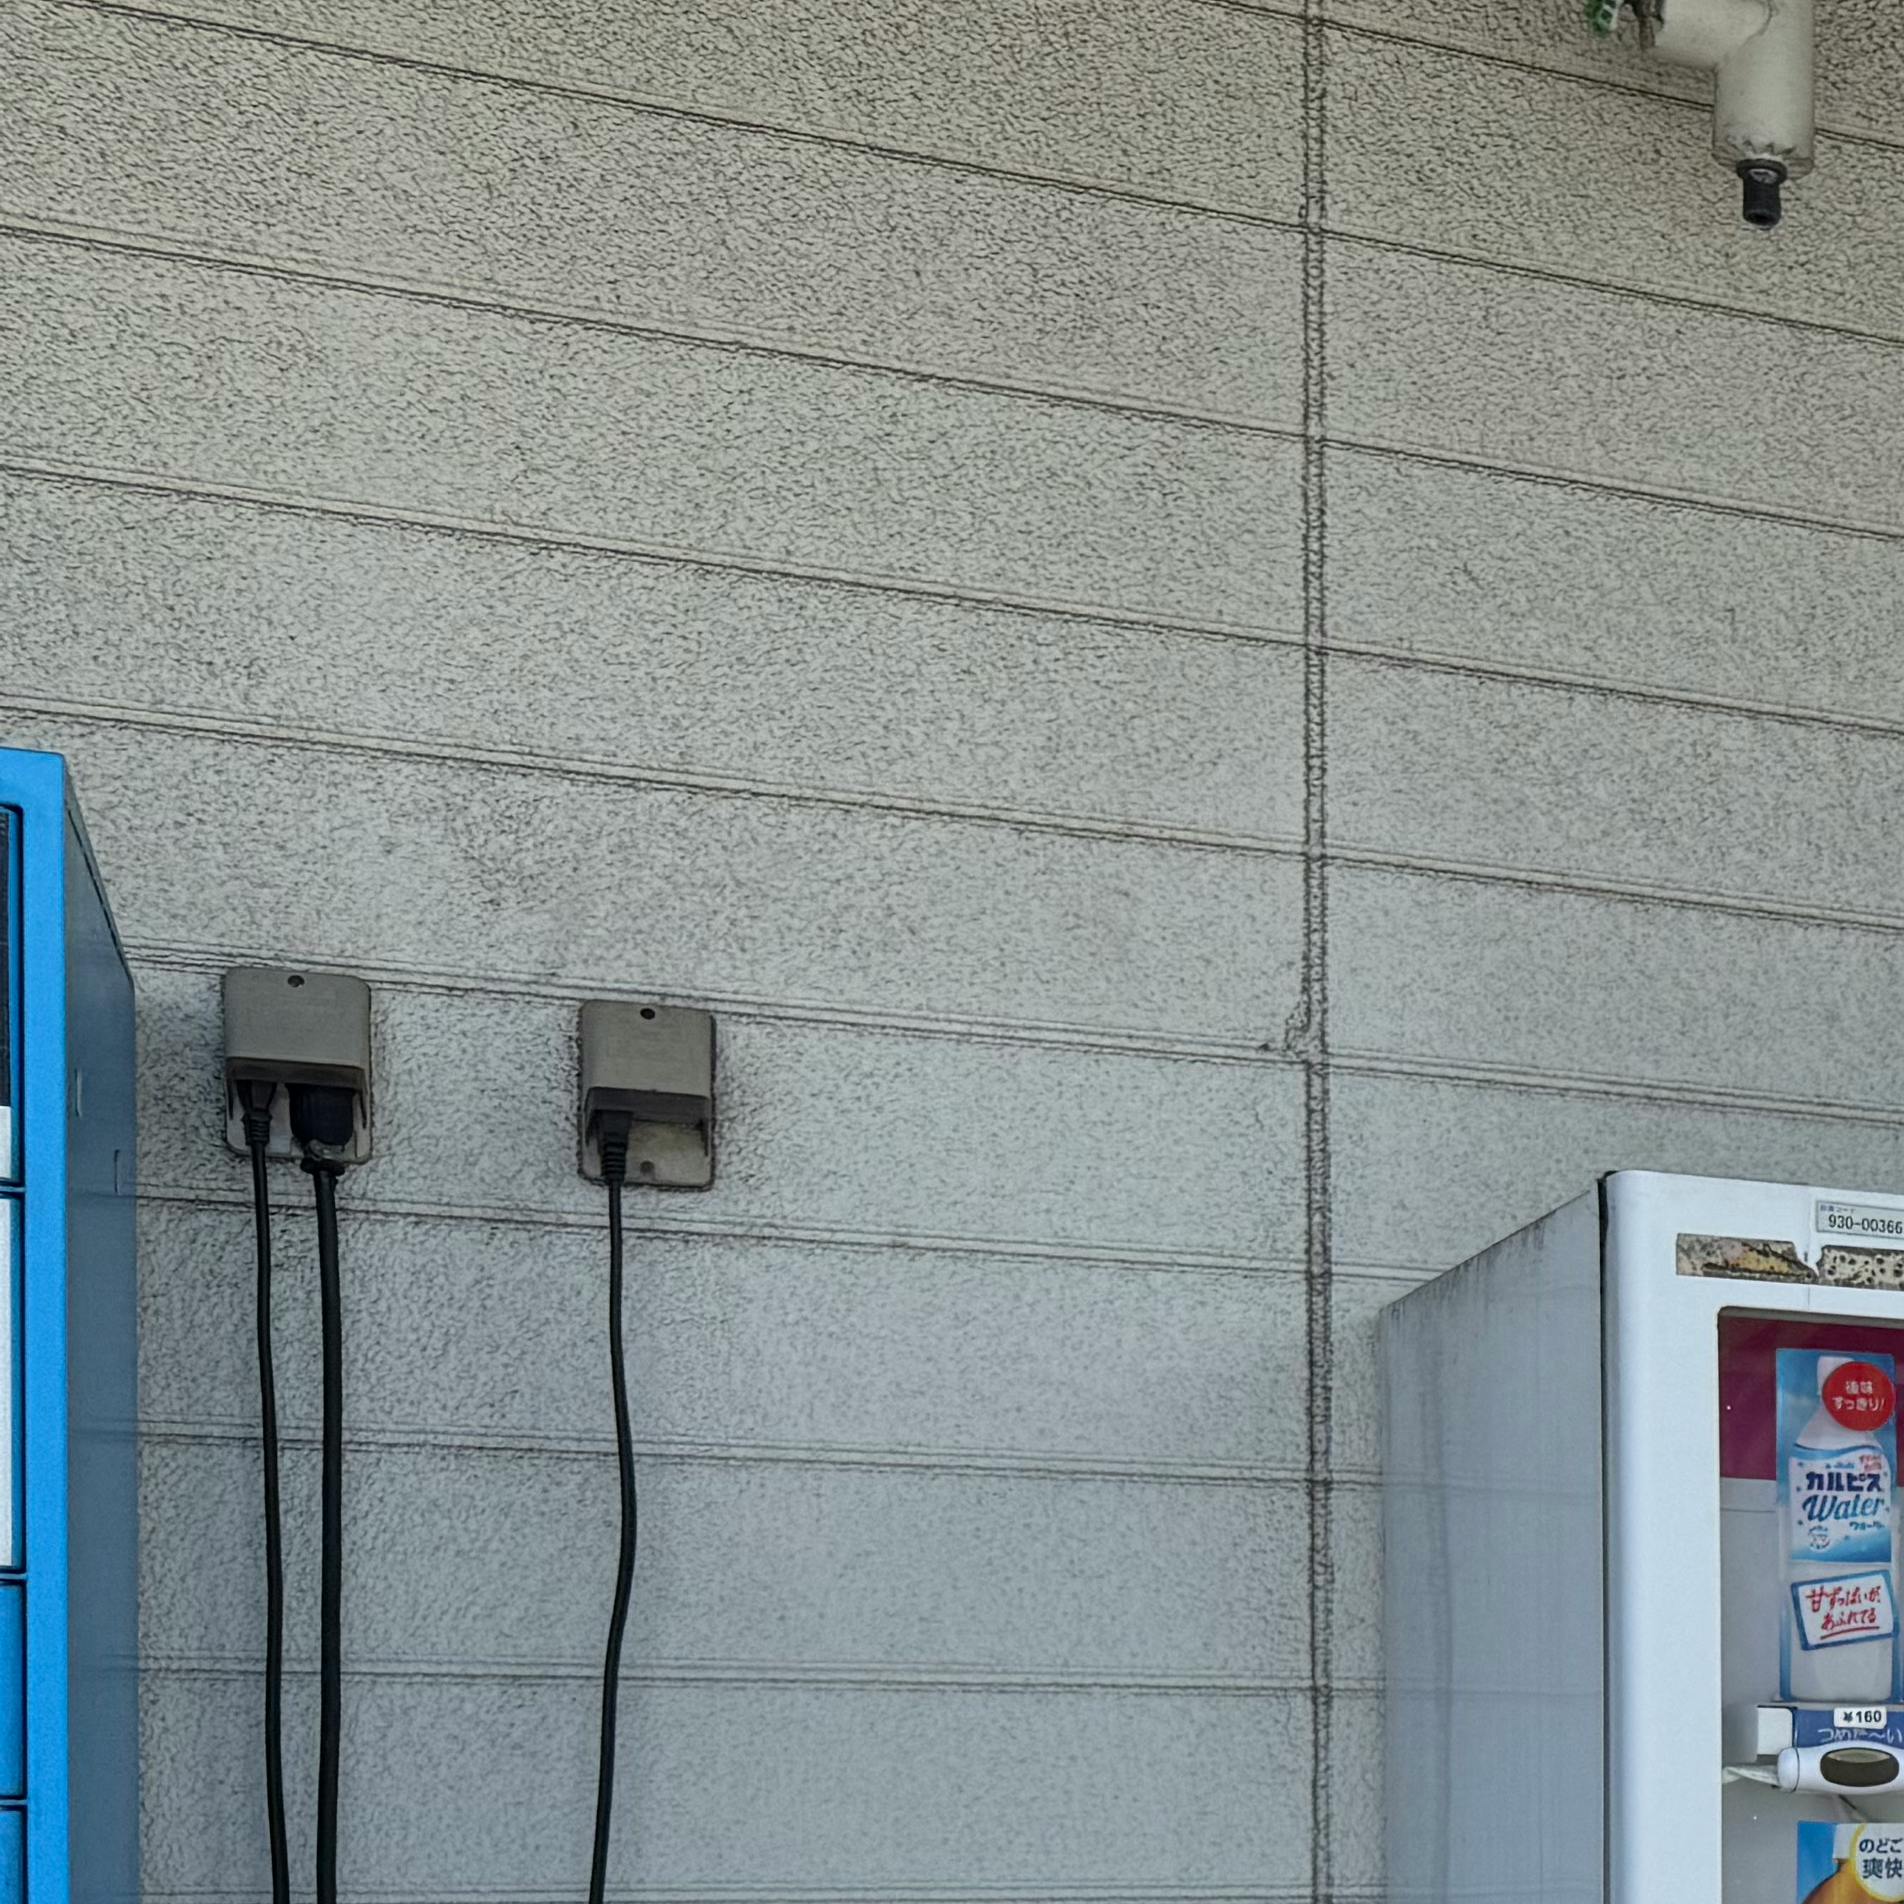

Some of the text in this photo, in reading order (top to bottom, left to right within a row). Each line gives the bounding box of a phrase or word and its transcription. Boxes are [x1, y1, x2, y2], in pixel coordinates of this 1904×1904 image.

[1805, 1471, 1883, 1493] カルピス
[1802, 1493, 1886, 1523] Water
